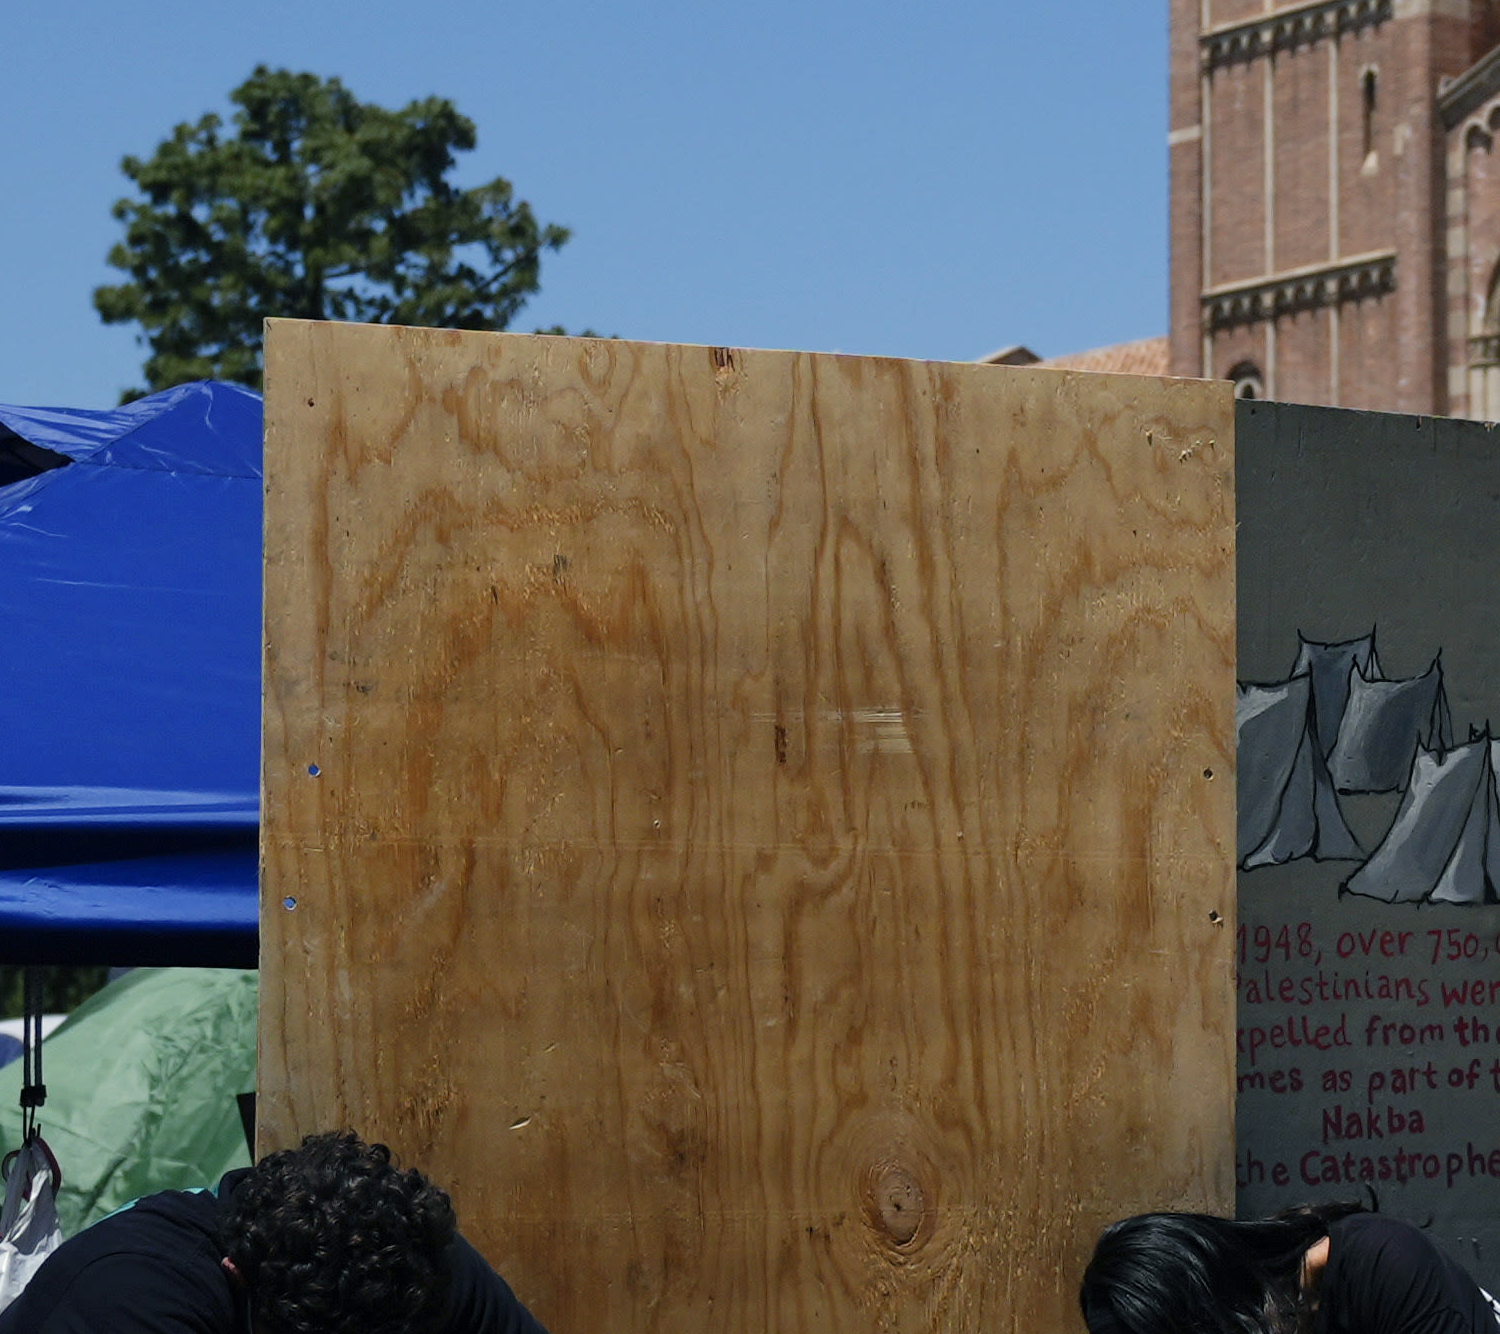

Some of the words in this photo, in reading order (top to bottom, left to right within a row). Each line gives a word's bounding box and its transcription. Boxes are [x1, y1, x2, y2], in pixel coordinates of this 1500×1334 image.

[1336, 928, 1414, 959] over
[1237, 970, 1430, 1008] alestinians
[1366, 1015, 1444, 1047] from
[1322, 1068, 1353, 1093] as
[1368, 1061, 1438, 1104] part
[1447, 1058, 1481, 1089] of
[1322, 1104, 1426, 1145] Nakba
